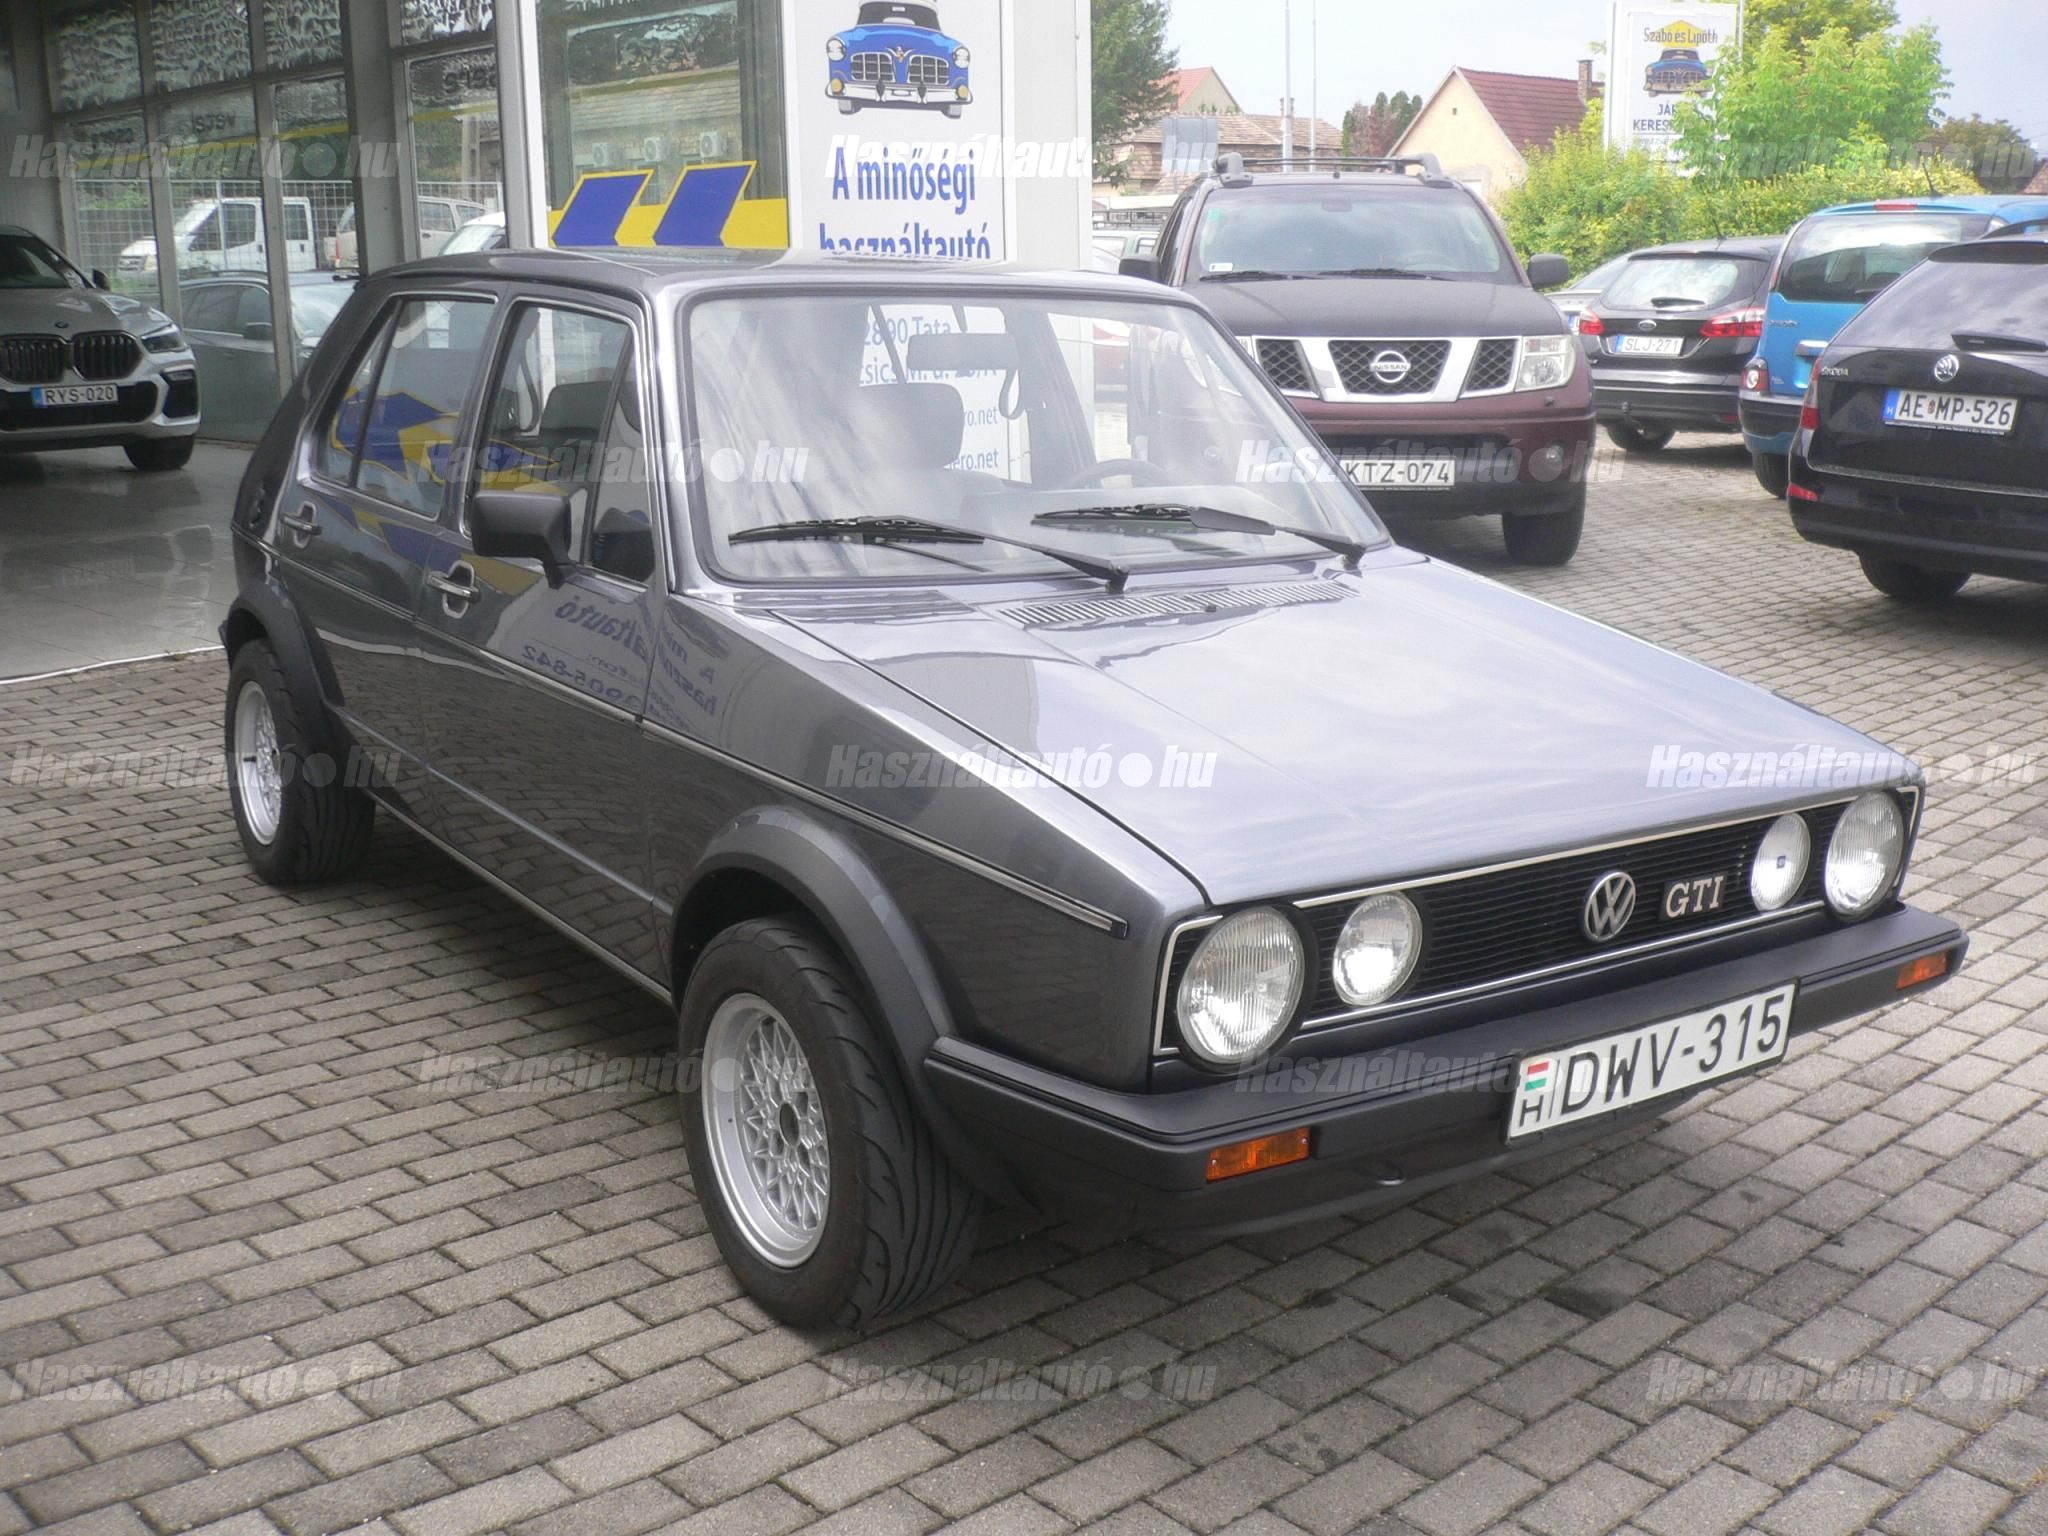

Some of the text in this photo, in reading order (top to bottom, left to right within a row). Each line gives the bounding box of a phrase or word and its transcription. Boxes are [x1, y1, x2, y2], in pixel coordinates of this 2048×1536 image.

[832, 146, 976, 216] A minőségi
[1624, 337, 1679, 351] SLJ-271
[1373, 363, 1409, 371] NISSAN
[44, 385, 114, 404] RYS-020
[1899, 393, 1927, 419] AE
[1934, 398, 2012, 427] MP-526
[1346, 462, 1450, 484] KTZ-074
[1665, 875, 1724, 920] GTI
[1518, 992, 1785, 1128] H DWV-315
